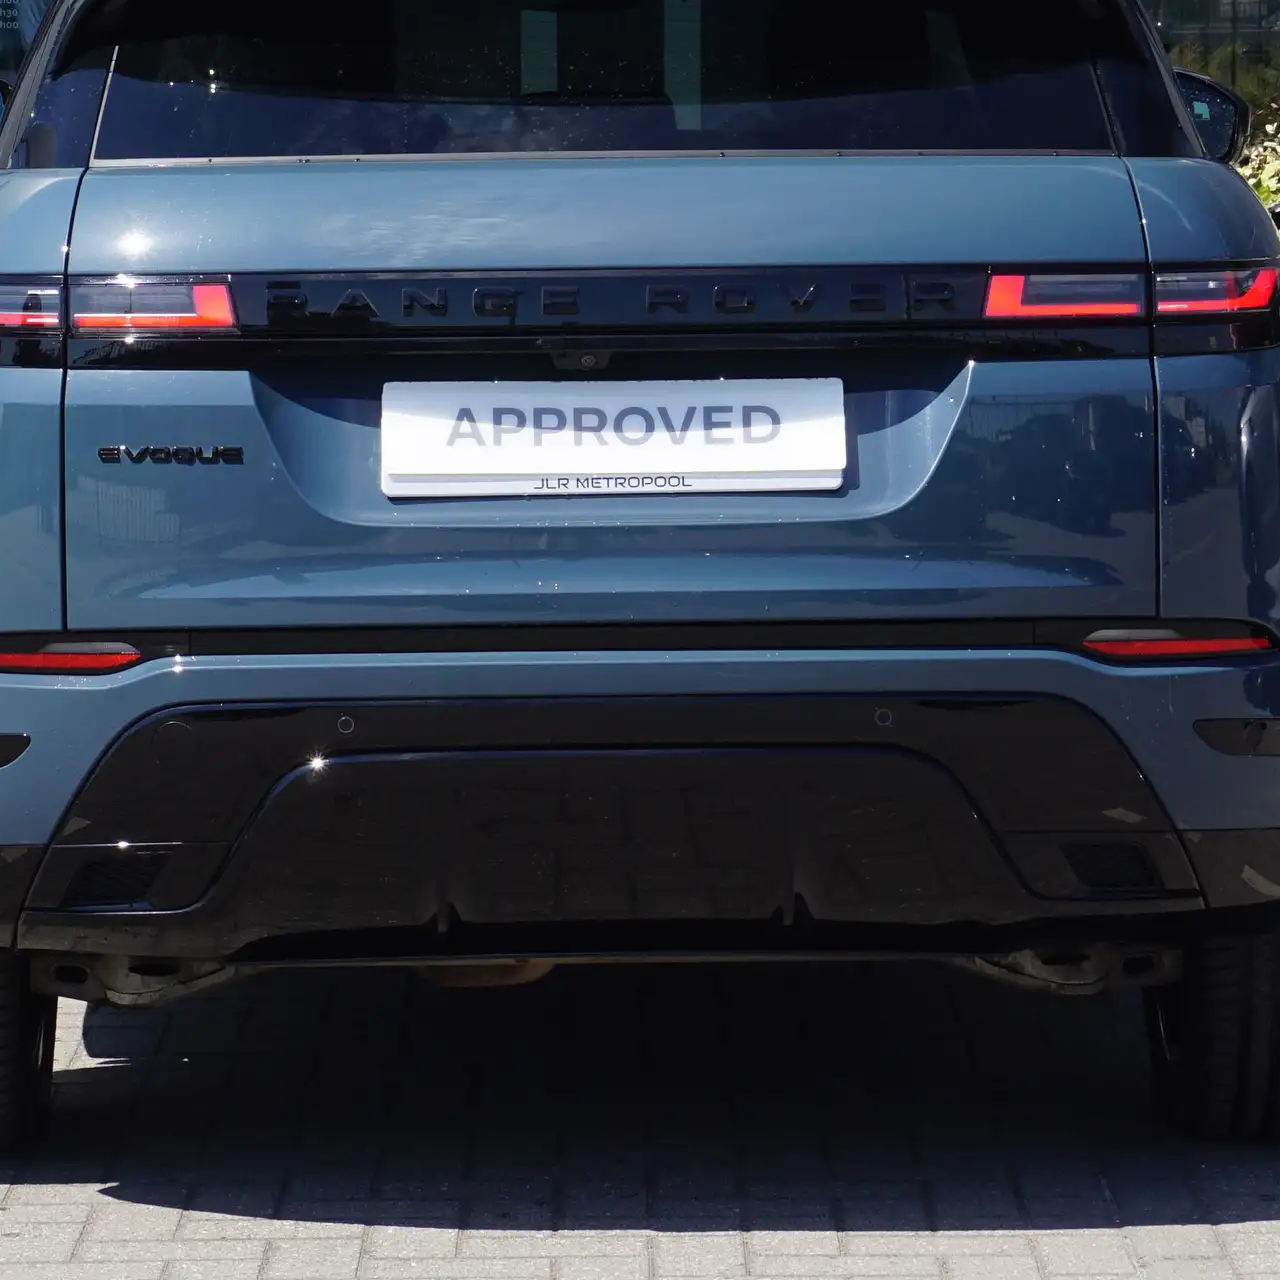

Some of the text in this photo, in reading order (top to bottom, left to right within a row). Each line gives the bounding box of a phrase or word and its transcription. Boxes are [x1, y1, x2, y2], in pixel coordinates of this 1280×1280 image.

[266, 282, 957, 317] RANGE ROVER
[445, 405, 782, 448] APPROVED
[97, 445, 245, 466] EVOQUE
[533, 476, 692, 490] JLR METROPOOL
